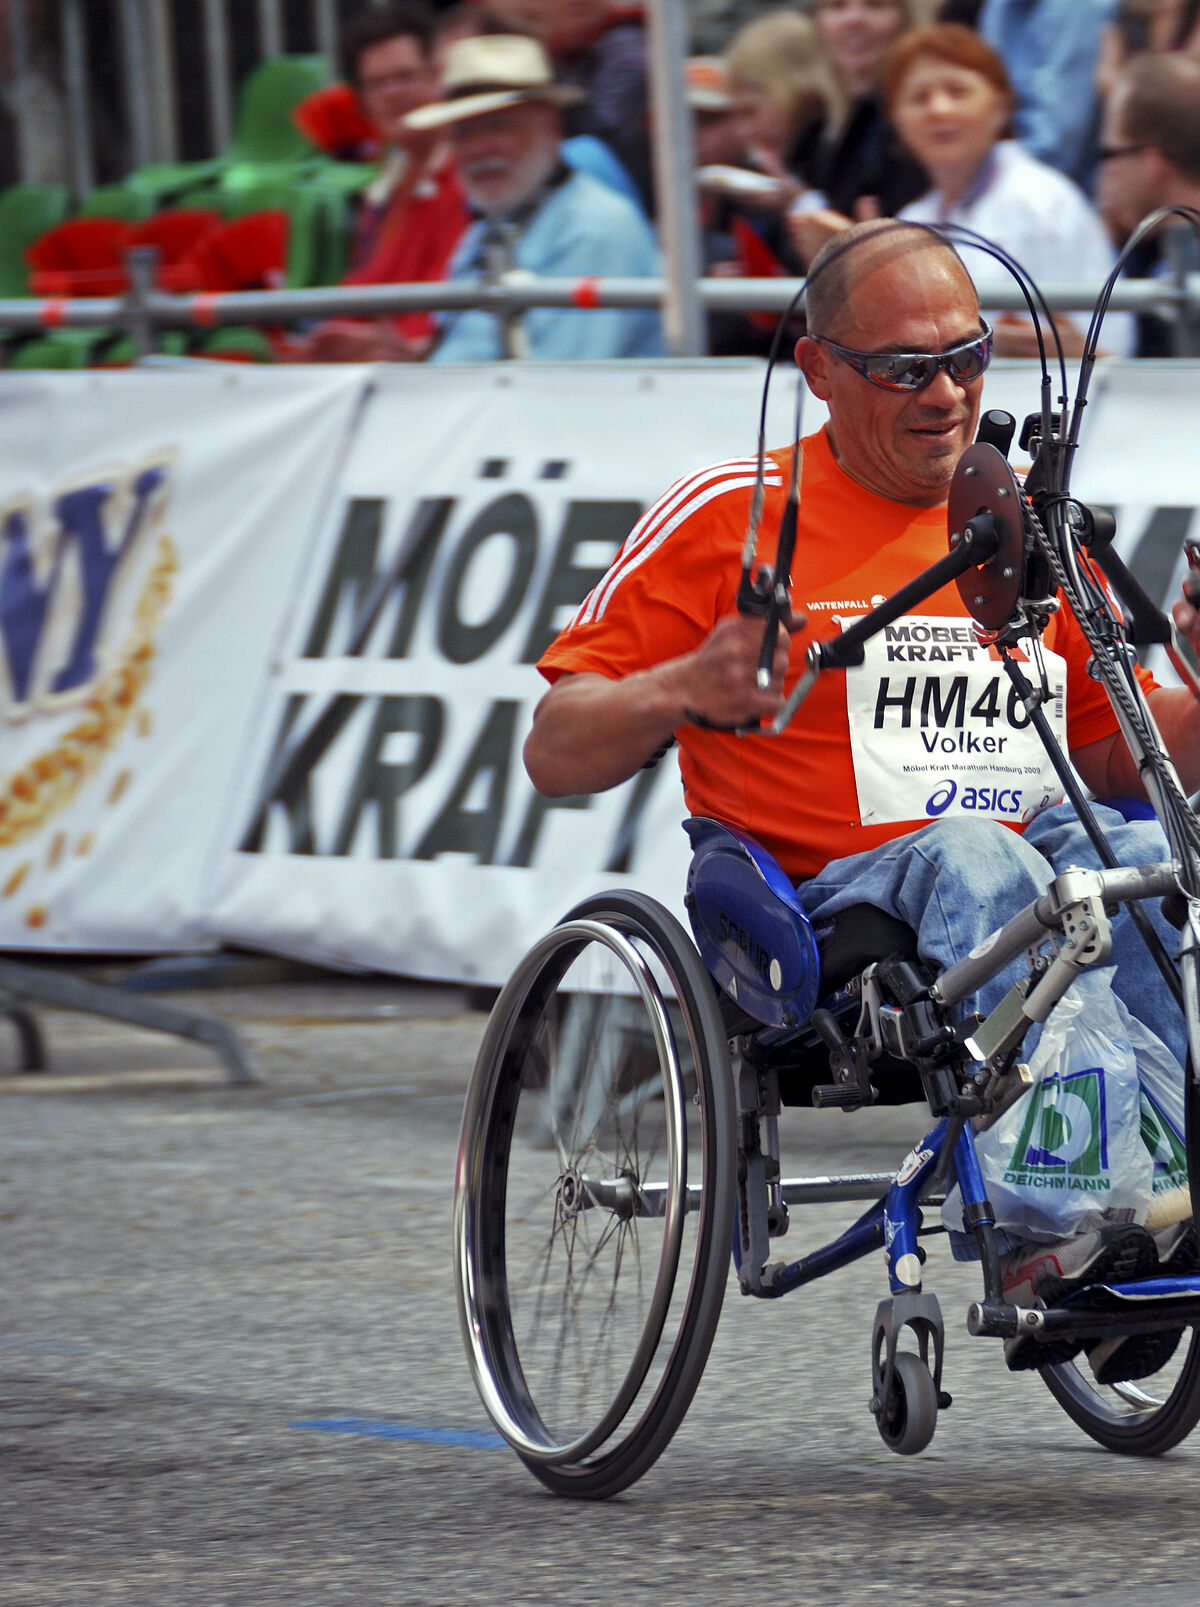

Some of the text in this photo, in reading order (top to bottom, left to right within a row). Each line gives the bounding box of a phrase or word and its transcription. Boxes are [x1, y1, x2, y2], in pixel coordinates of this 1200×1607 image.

[302, 458, 646, 667] MÖB
[806, 600, 869, 611] VATTENFALL
[887, 645, 978, 662] KRAFT
[920, 731, 1008, 754] Volker
[903, 763, 1041, 775] Möbel Kraft Marathon Hamburg 2009
[1002, 1172, 1111, 1190] DEICHMANN
